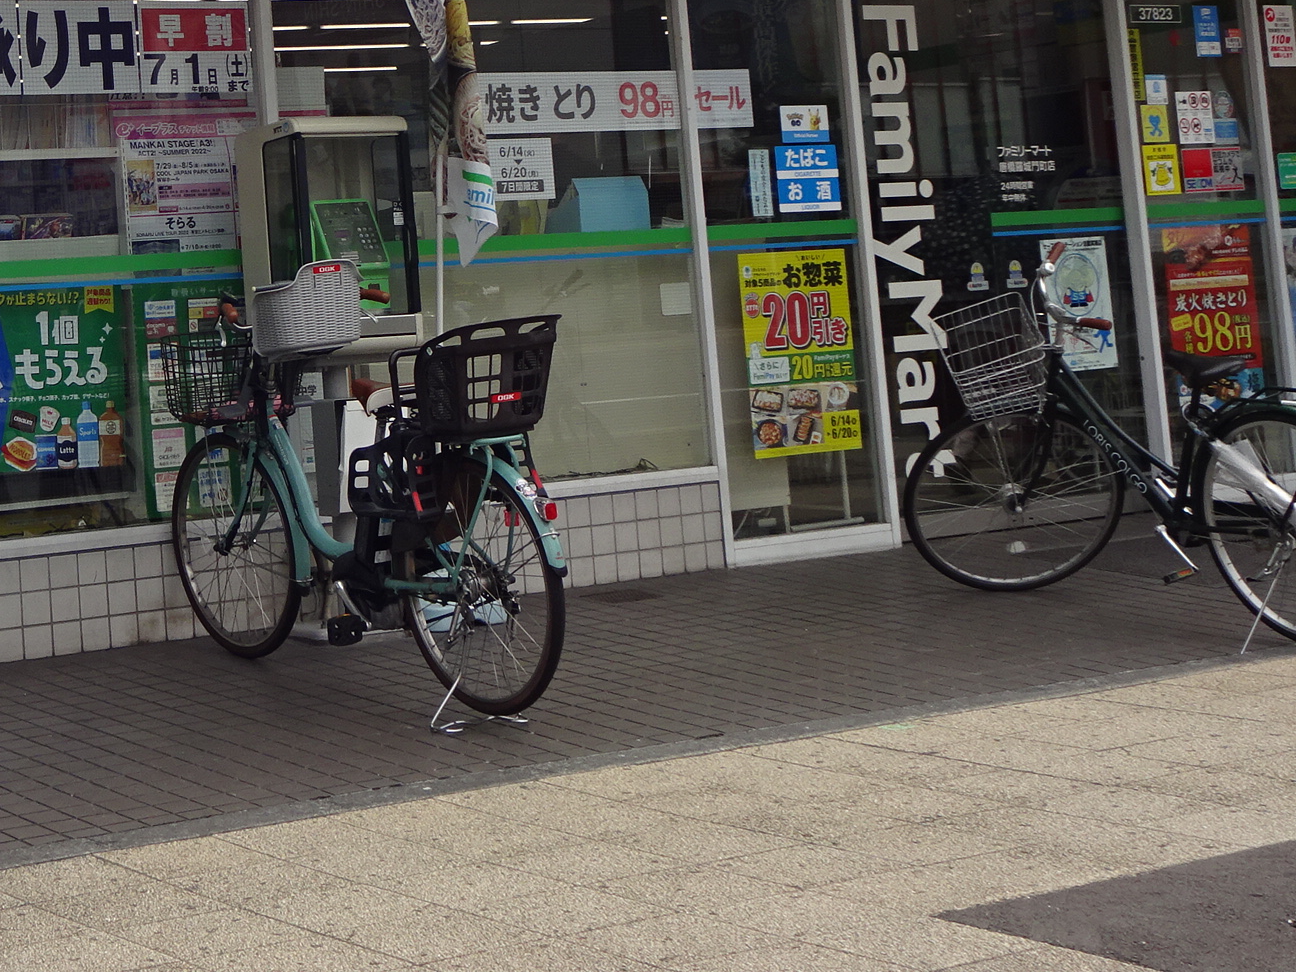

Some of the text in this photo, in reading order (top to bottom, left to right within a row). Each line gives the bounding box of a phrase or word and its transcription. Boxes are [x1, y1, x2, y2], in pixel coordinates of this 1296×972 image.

[1138, 7, 1173, 20] 37823
[484, 81, 746, 124] 焼きとり 98円 セール
[130, 139, 196, 150] MANKAI STAGE
[997, 145, 1052, 157] ファミリーマート
[785, 148, 828, 167] たばこ
[788, 181, 832, 201] お酒
[165, 216, 197, 230] そらる
[782, 260, 844, 289] お惣菜
[1175, 289, 1247, 312] 炭火焼きとり
[35, 310, 79, 346] 1個
[14, 346, 108, 390] もらえる
[496, 392, 515, 401] OGK
[59, 444, 75, 454] Latte
